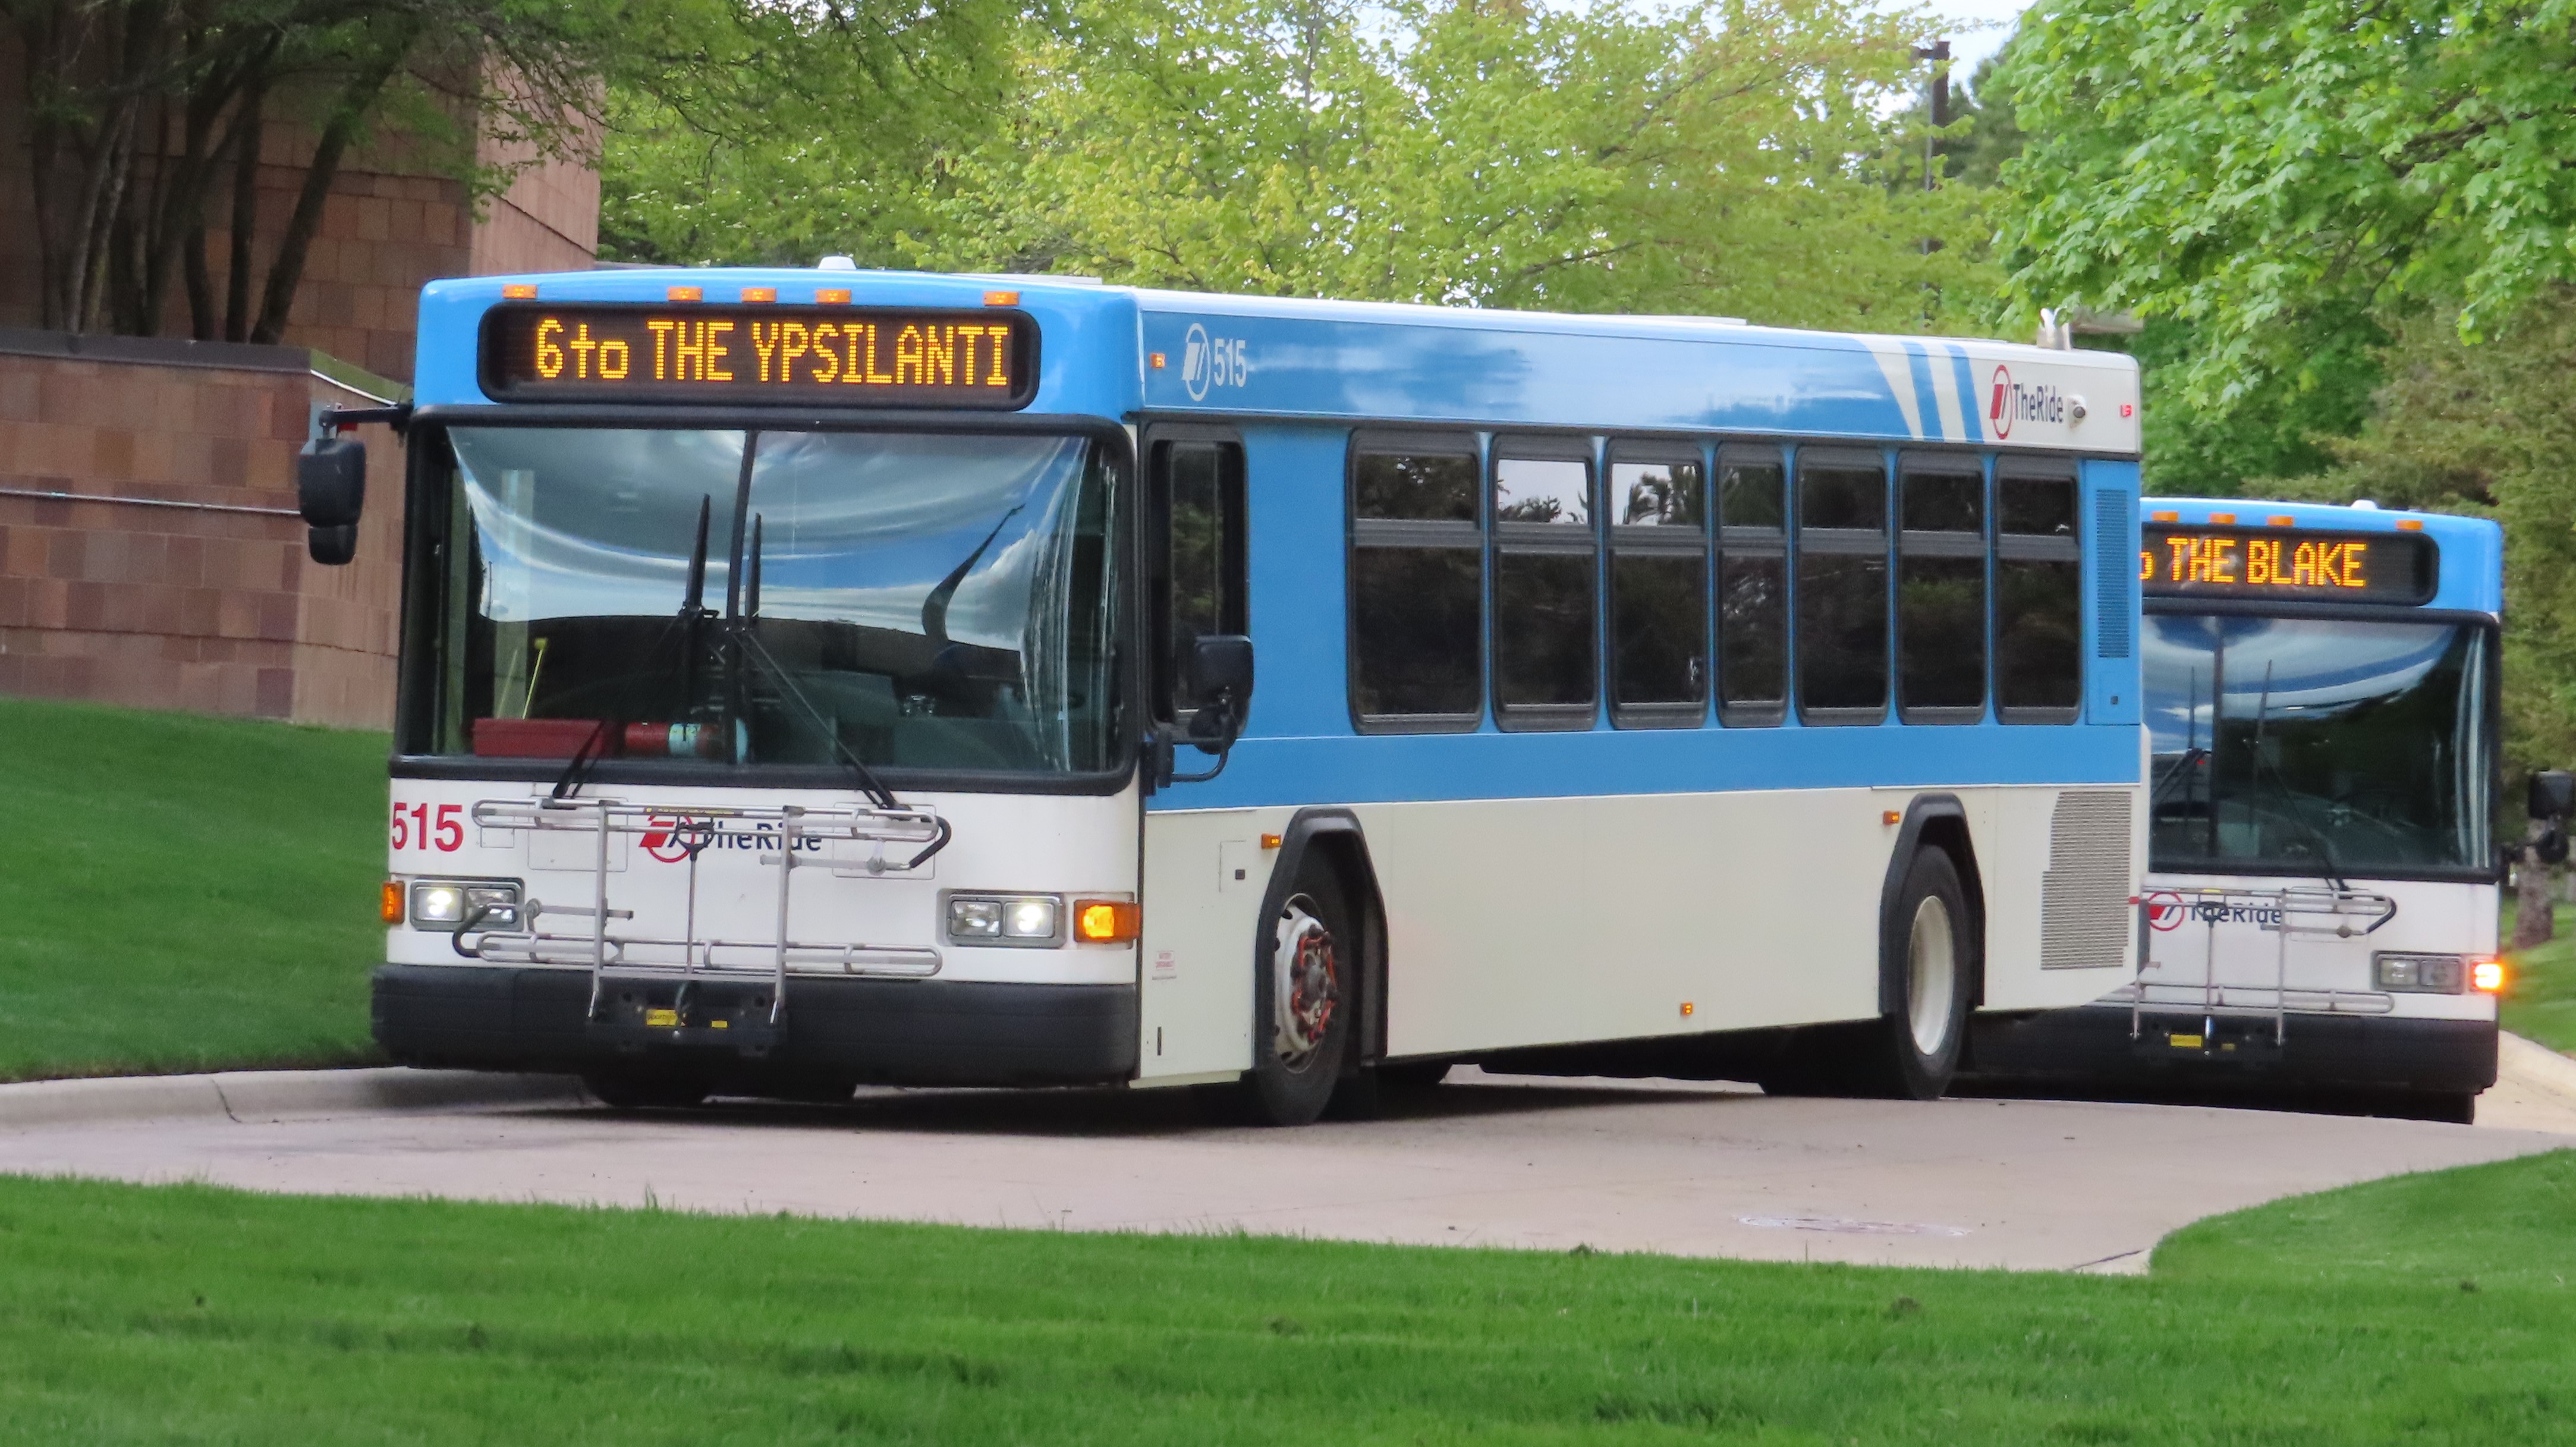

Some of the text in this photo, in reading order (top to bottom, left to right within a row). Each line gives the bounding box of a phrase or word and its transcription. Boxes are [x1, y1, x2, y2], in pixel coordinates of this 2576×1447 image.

[647, 320, 735, 382] THE
[752, 323, 1009, 386] YPSILANTI
[1214, 338, 1247, 388] 515
[2014, 383, 2064, 424] TheRide
[2166, 537, 2235, 583] THE
[2247, 540, 2367, 587] BLAKE
[392, 803, 464, 852] 515
